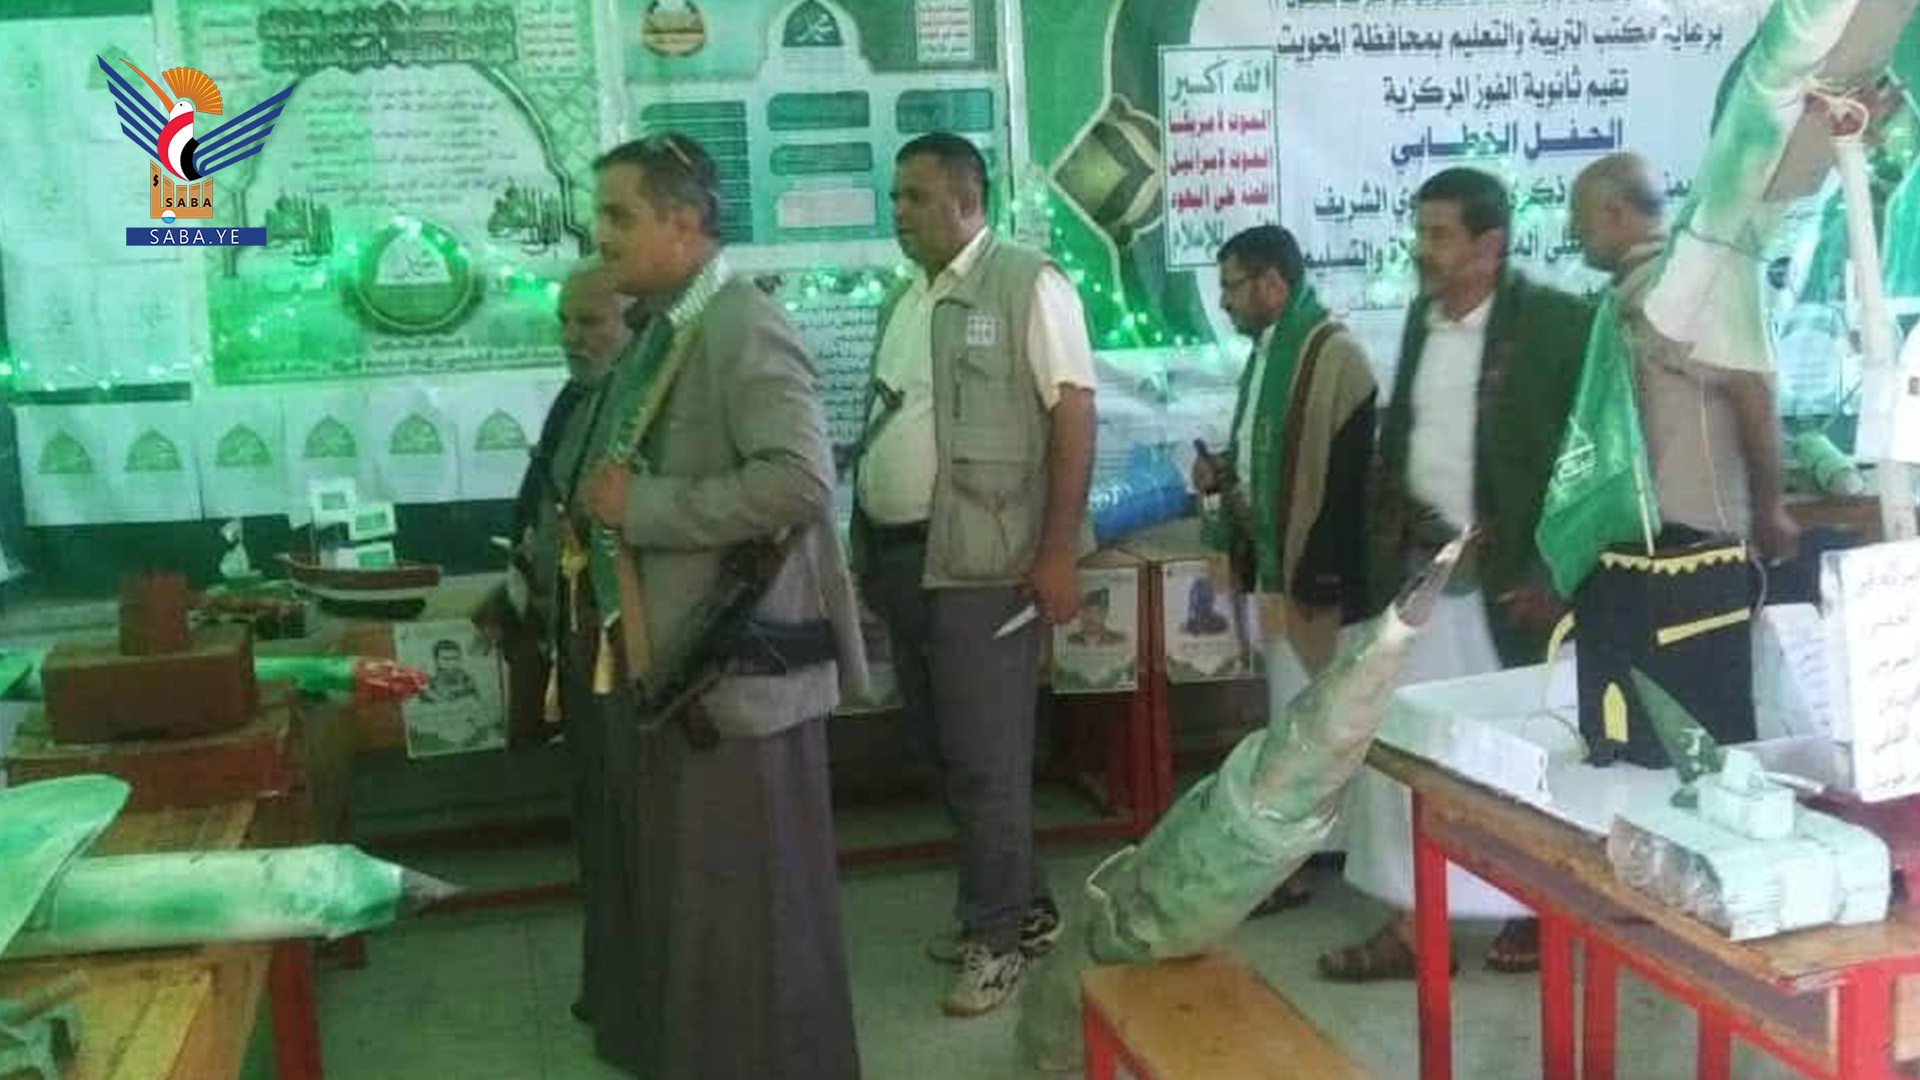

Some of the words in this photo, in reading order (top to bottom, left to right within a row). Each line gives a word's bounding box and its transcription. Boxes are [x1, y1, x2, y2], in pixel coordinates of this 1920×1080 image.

[1278, 24, 1346, 62] المحويت
[1352, 22, 1442, 57] بمحافظة
[1451, 18, 1523, 58] والتعليم
[1528, 17, 1589, 56] التربية
[1593, 16, 1657, 53] مكتب
[1663, 13, 1723, 54] برعاية
[1233, 61, 1271, 93] الله
[1383, 75, 1470, 112] المركزية
[1475, 72, 1518, 109] الفوز
[1523, 65, 1582, 108] ثانوية
[1586, 68, 1629, 105] تقيم
[1391, 121, 1518, 172] الخطابي
[1524, 116, 1623, 159] الحفل
[1314, 181, 1387, 222] الشريف
